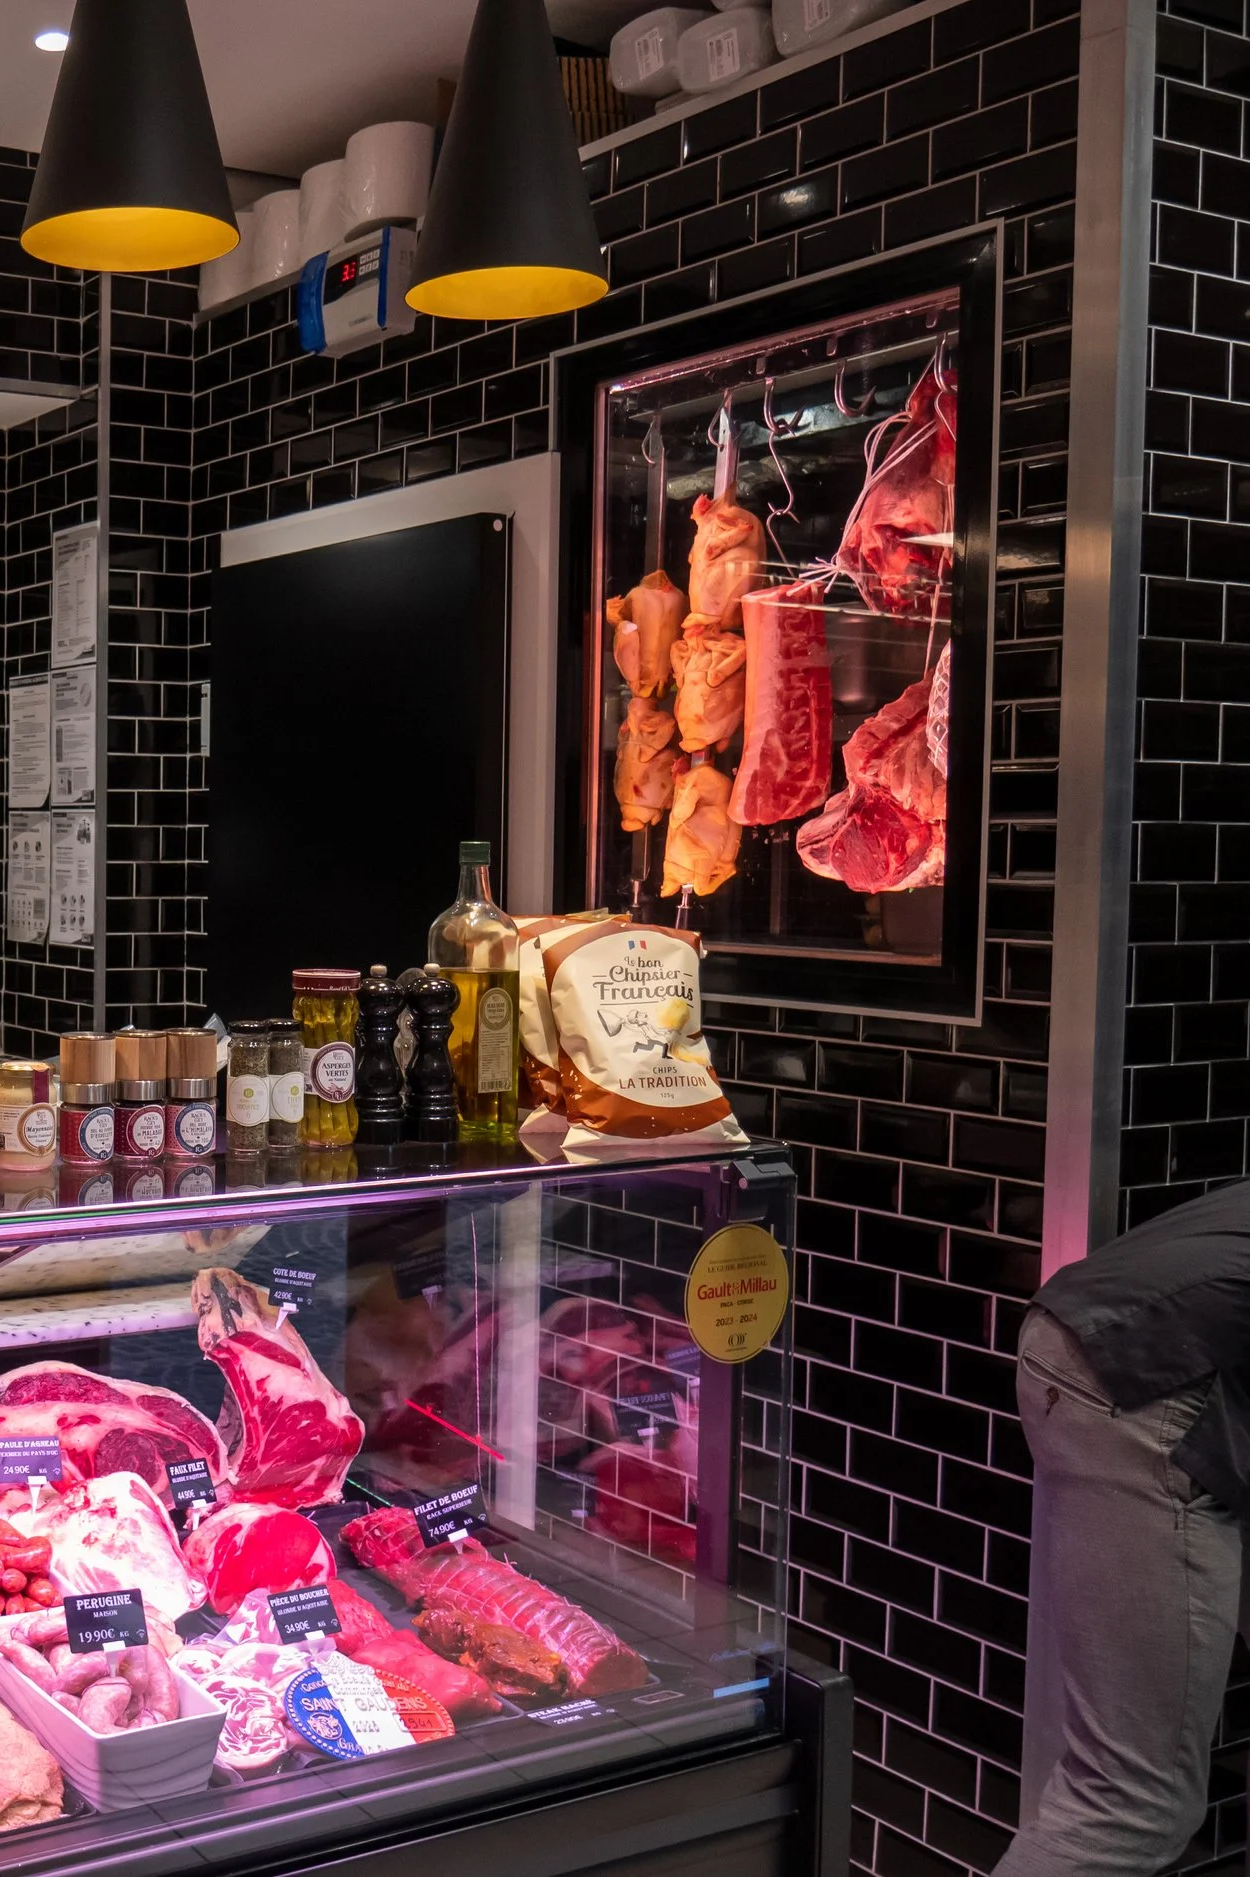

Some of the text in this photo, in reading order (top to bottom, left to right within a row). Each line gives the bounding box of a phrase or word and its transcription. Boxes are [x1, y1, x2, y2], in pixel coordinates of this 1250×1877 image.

[638, 957, 663, 968] bon
[609, 965, 681, 985] Chipsier
[593, 981, 694, 1002] Français
[653, 1066, 678, 1075] CHIPS
[618, 1076, 707, 1089] LA TRADITION
[273, 1268, 317, 1281] COTE DE BOEUF
[716, 1314, 758, 1327] 2023 2024
[24, 1440, 60, 1448] D'AGNEAU
[170, 1461, 205, 1476] FAUX FILET
[414, 1484, 478, 1516] FILET DE BOEUF
[290, 1594, 299, 1603] DU
[298, 1588, 329, 1602] BOUCHER
[76, 1594, 133, 1611] PERUGINE
[93, 1610, 118, 1618] MAISON
[120, 1630, 130, 1638] KG
[302, 1698, 347, 1712] SAINT
